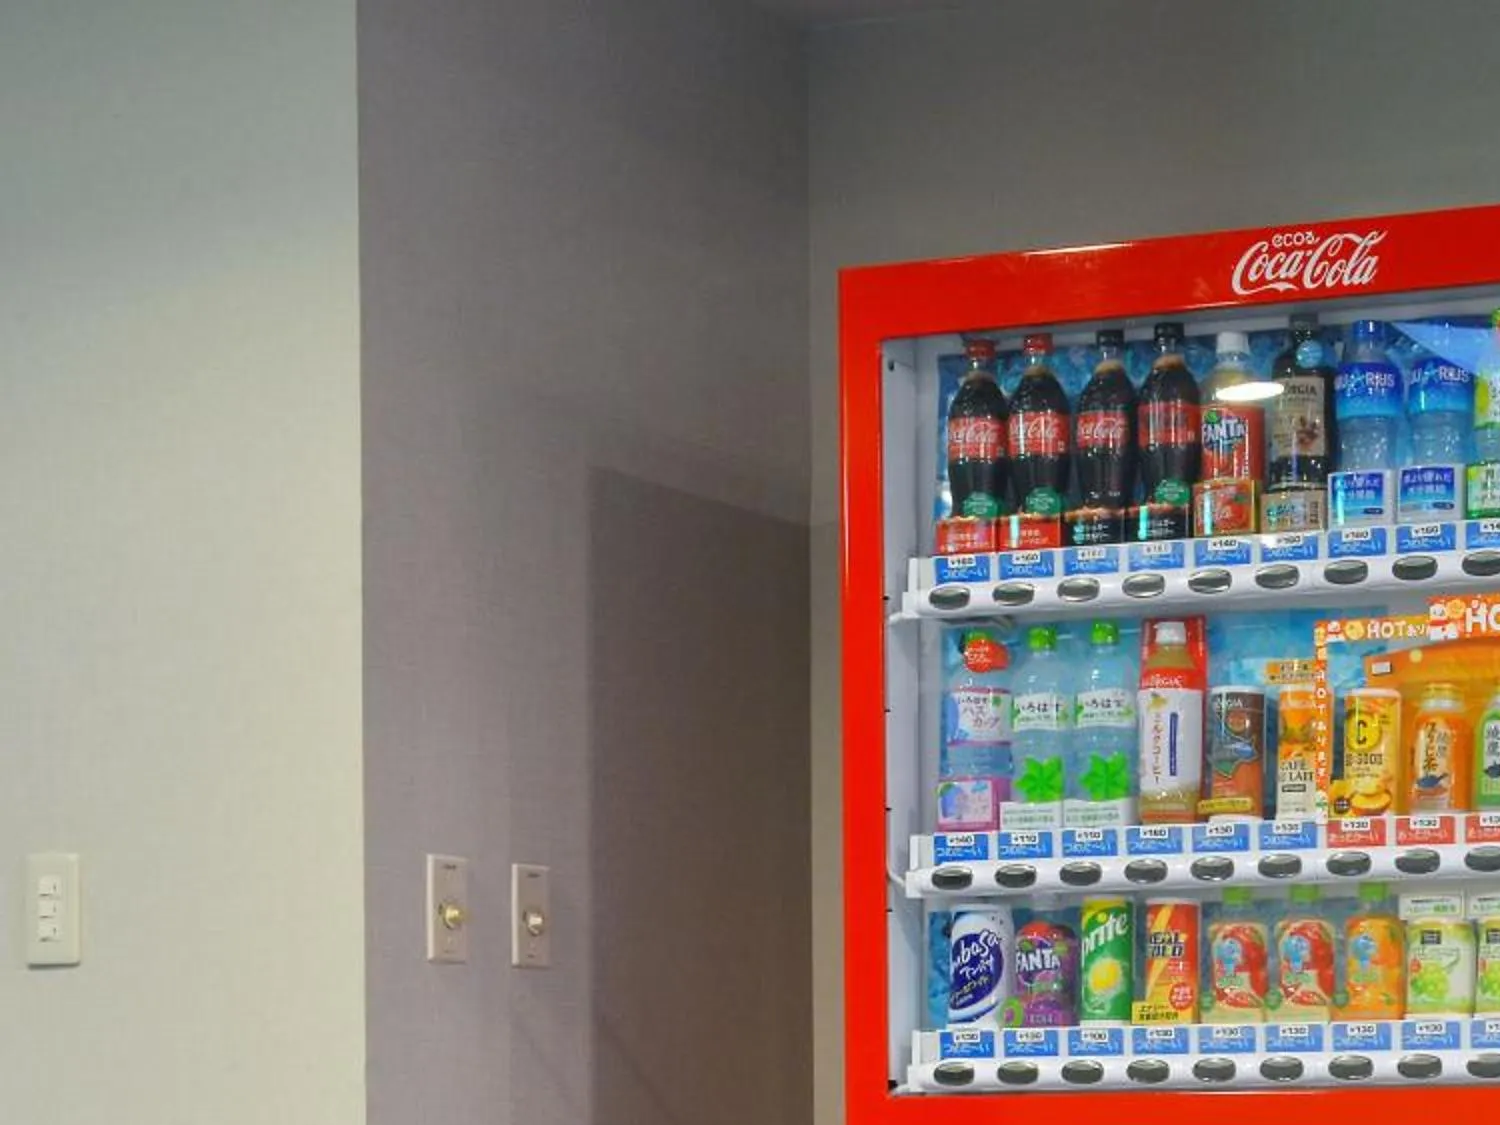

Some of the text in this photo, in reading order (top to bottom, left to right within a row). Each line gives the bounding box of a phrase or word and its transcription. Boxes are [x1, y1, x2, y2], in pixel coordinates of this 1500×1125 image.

[1232, 230, 1388, 295] Coca-Cola
[1082, 912, 1127, 954] prite
[1016, 948, 1061, 973] FANTA
